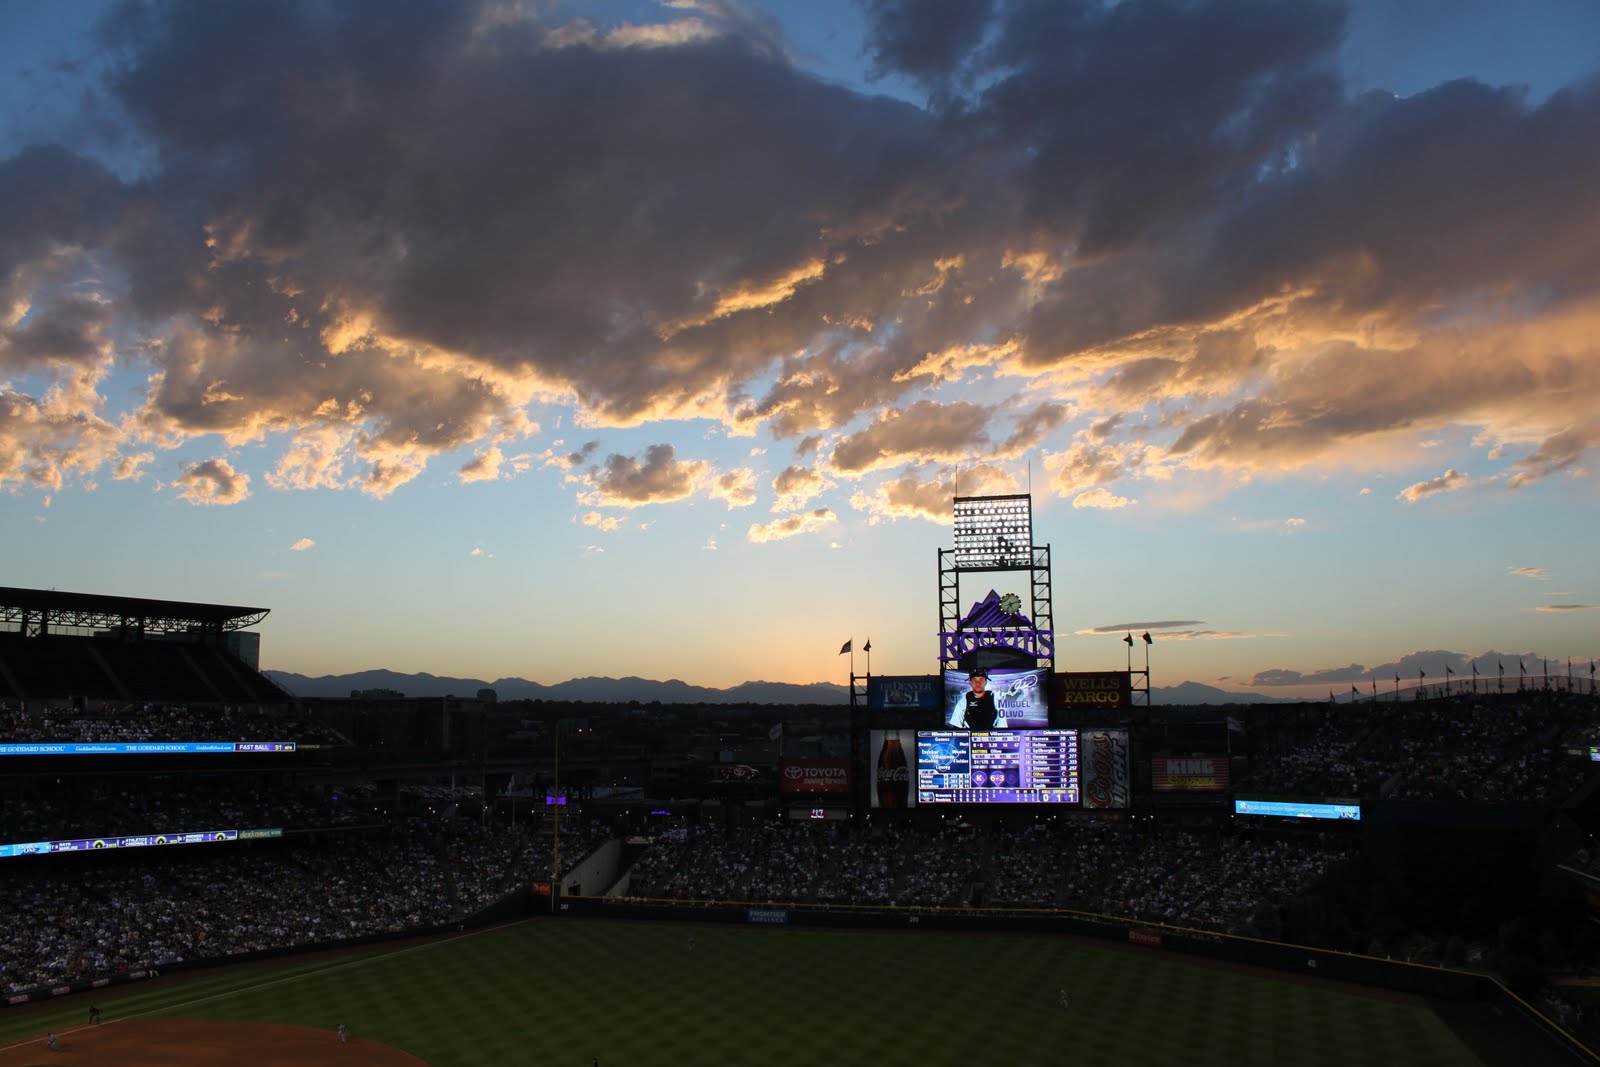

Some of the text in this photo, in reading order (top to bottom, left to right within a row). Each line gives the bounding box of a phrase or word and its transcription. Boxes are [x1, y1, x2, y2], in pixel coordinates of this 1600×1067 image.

[937, 629, 1055, 660] ROCKIES
[894, 681, 932, 690] DENVER
[1064, 678, 1120, 689] WELLS
[883, 690, 920, 702] POST
[1064, 691, 1120, 702] FARGO
[804, 768, 846, 777] TOYOTA
[1087, 734, 1114, 808] Coors
[1112, 738, 1128, 806] LIGHT
[1167, 760, 1215, 774] KING
[1043, 794, 1048, 802] 0
[1056, 794, 1060, 802] 1
[1069, 794, 1073, 802] 1
